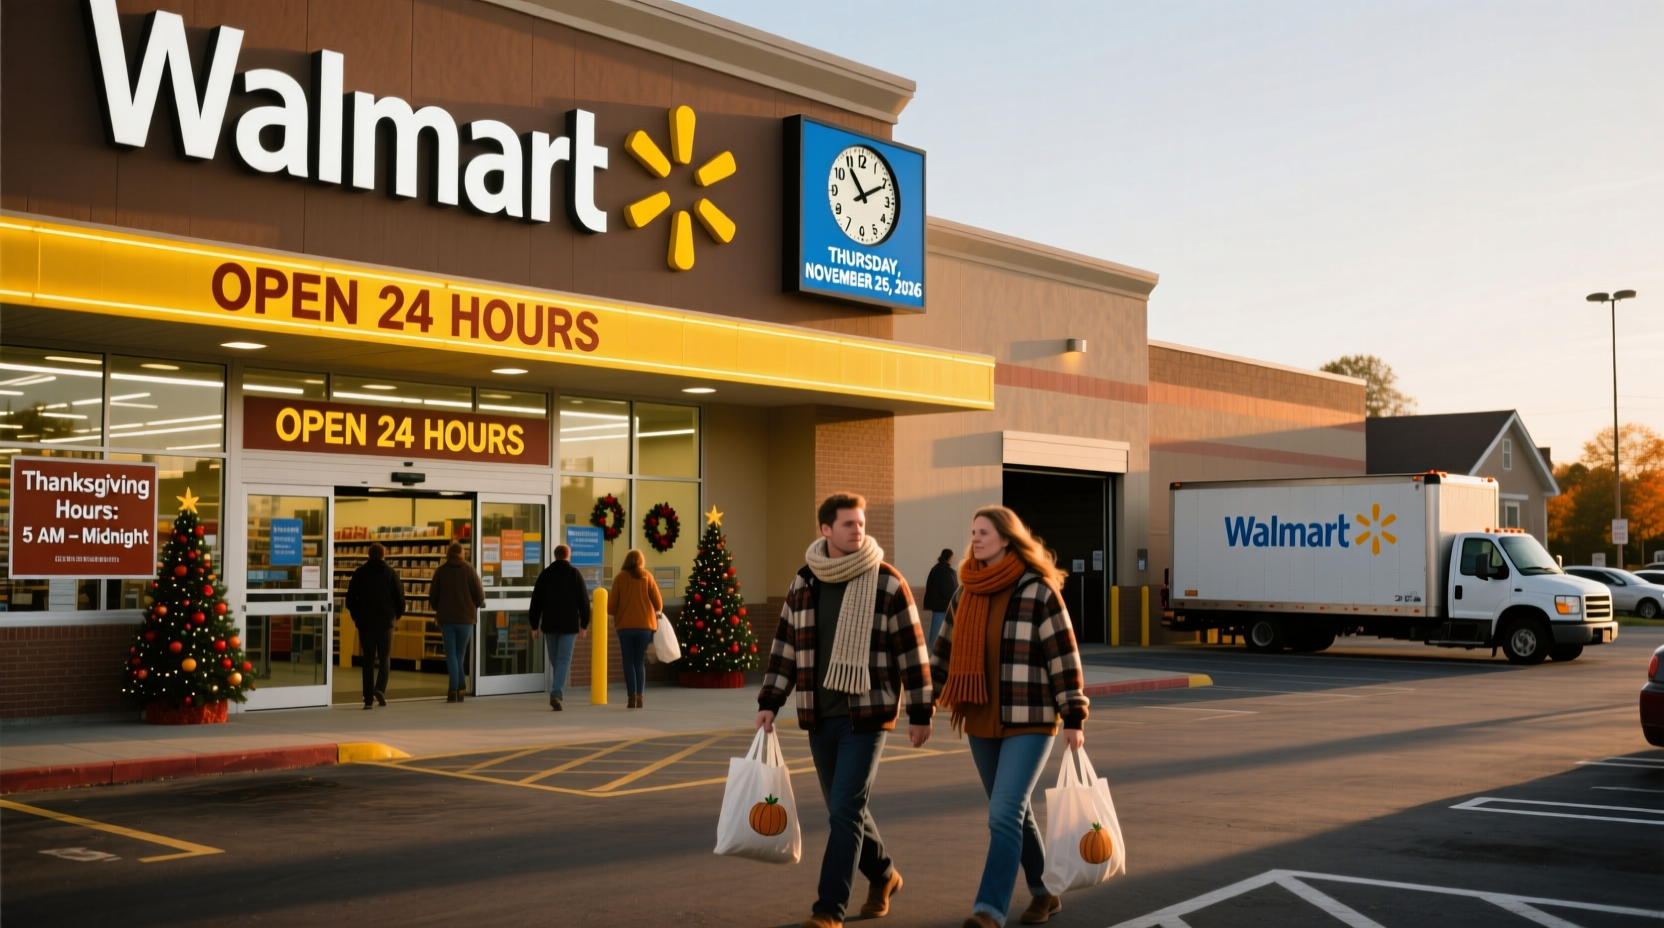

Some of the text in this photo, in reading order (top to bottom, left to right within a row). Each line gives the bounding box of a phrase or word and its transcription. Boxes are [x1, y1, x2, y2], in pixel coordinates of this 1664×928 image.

[86, 0, 608, 233] Walmart
[834, 166, 846, 181] 10
[846, 155, 854, 168] 11
[858, 154, 867, 169] 12
[845, 216, 852, 232] 7
[805, 262, 873, 290] NOVEMBER
[827, 246, 901, 279] THURSDAY,
[212, 262, 599, 352] OPEN 24 HOURS
[275, 407, 525, 456] OPEN 24 HOURS
[22, 470, 150, 500] Thanksgiving
[55, 499, 119, 520] Hours:
[22, 526, 33, 543] 5
[37, 527, 65, 544] AM
[82, 527, 149, 549] Midnight
[1225, 514, 1350, 548] Walmart
